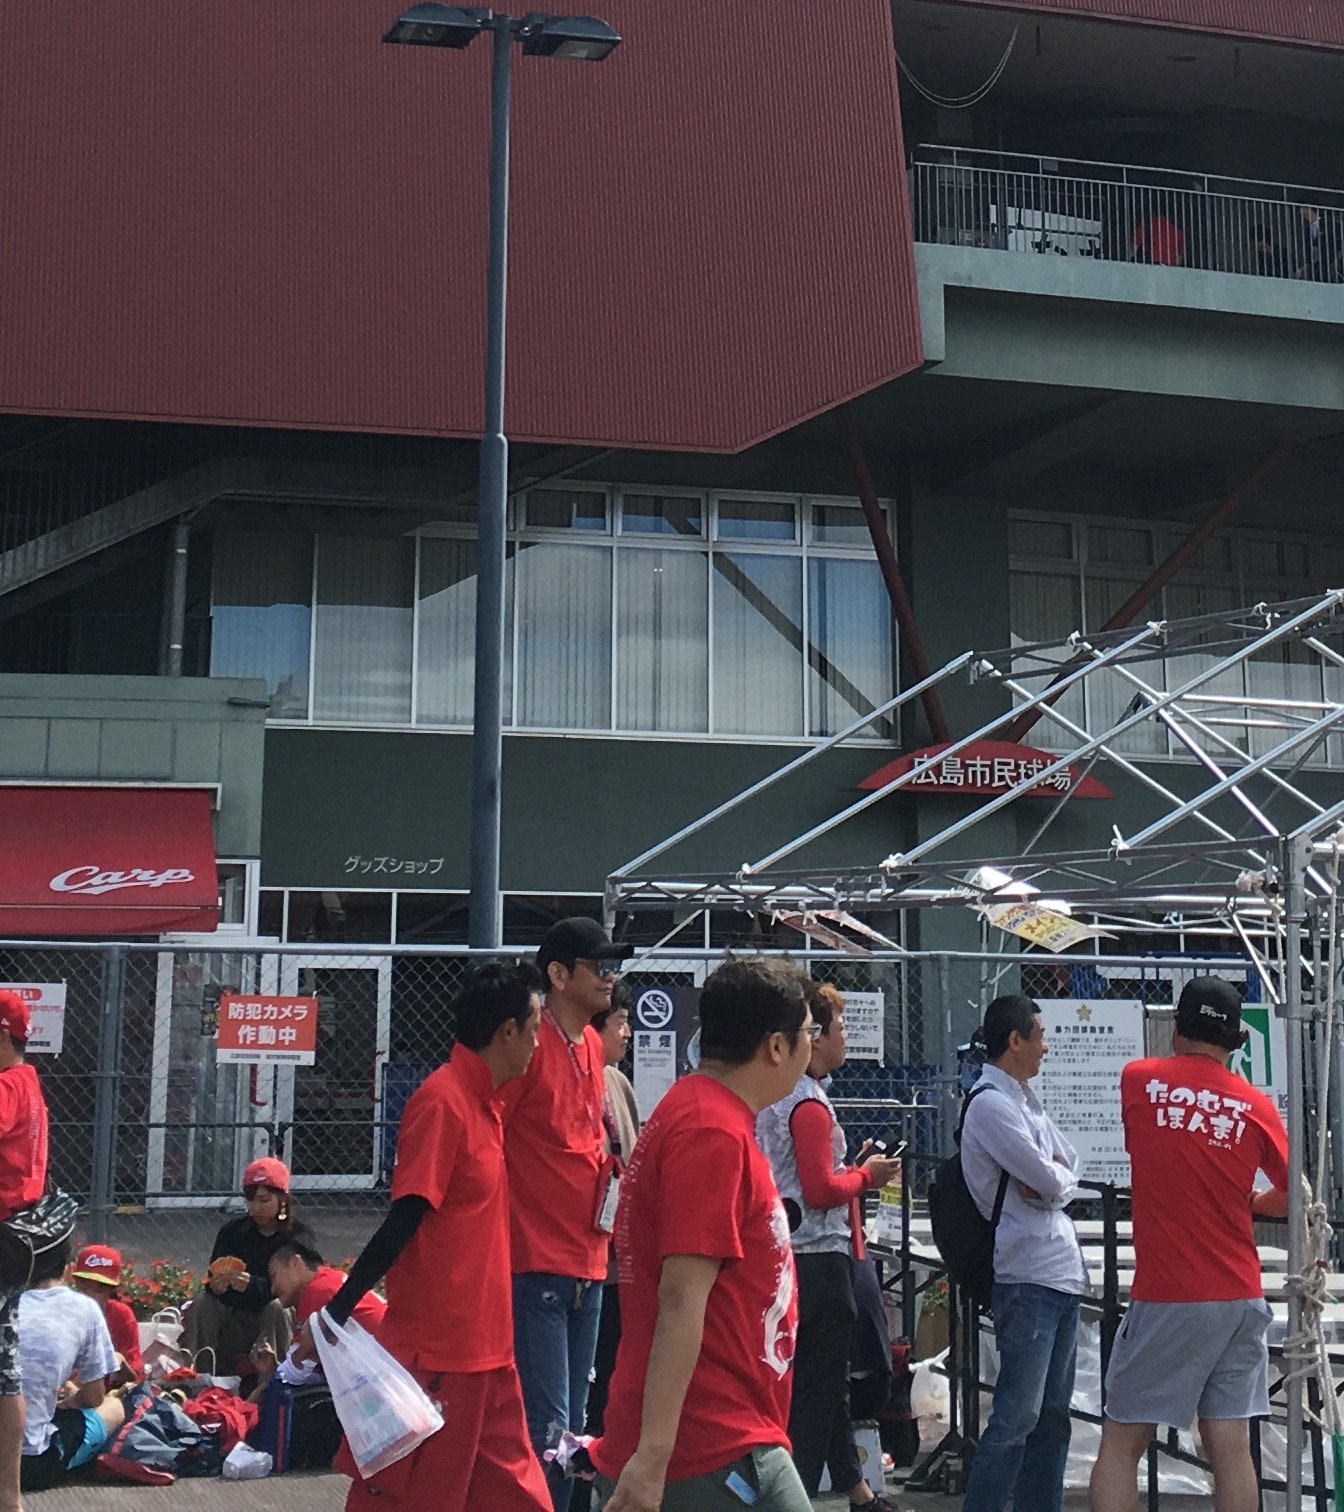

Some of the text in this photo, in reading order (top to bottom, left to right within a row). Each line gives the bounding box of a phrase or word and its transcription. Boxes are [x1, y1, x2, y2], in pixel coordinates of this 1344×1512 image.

[344, 856, 445, 875] グッズショップ
[49, 865, 195, 895] Carp
[228, 1002, 308, 1021] 防犯カメラ
[237, 1025, 297, 1045] 作動中
[1145, 1078, 1252, 1120] たのむで
